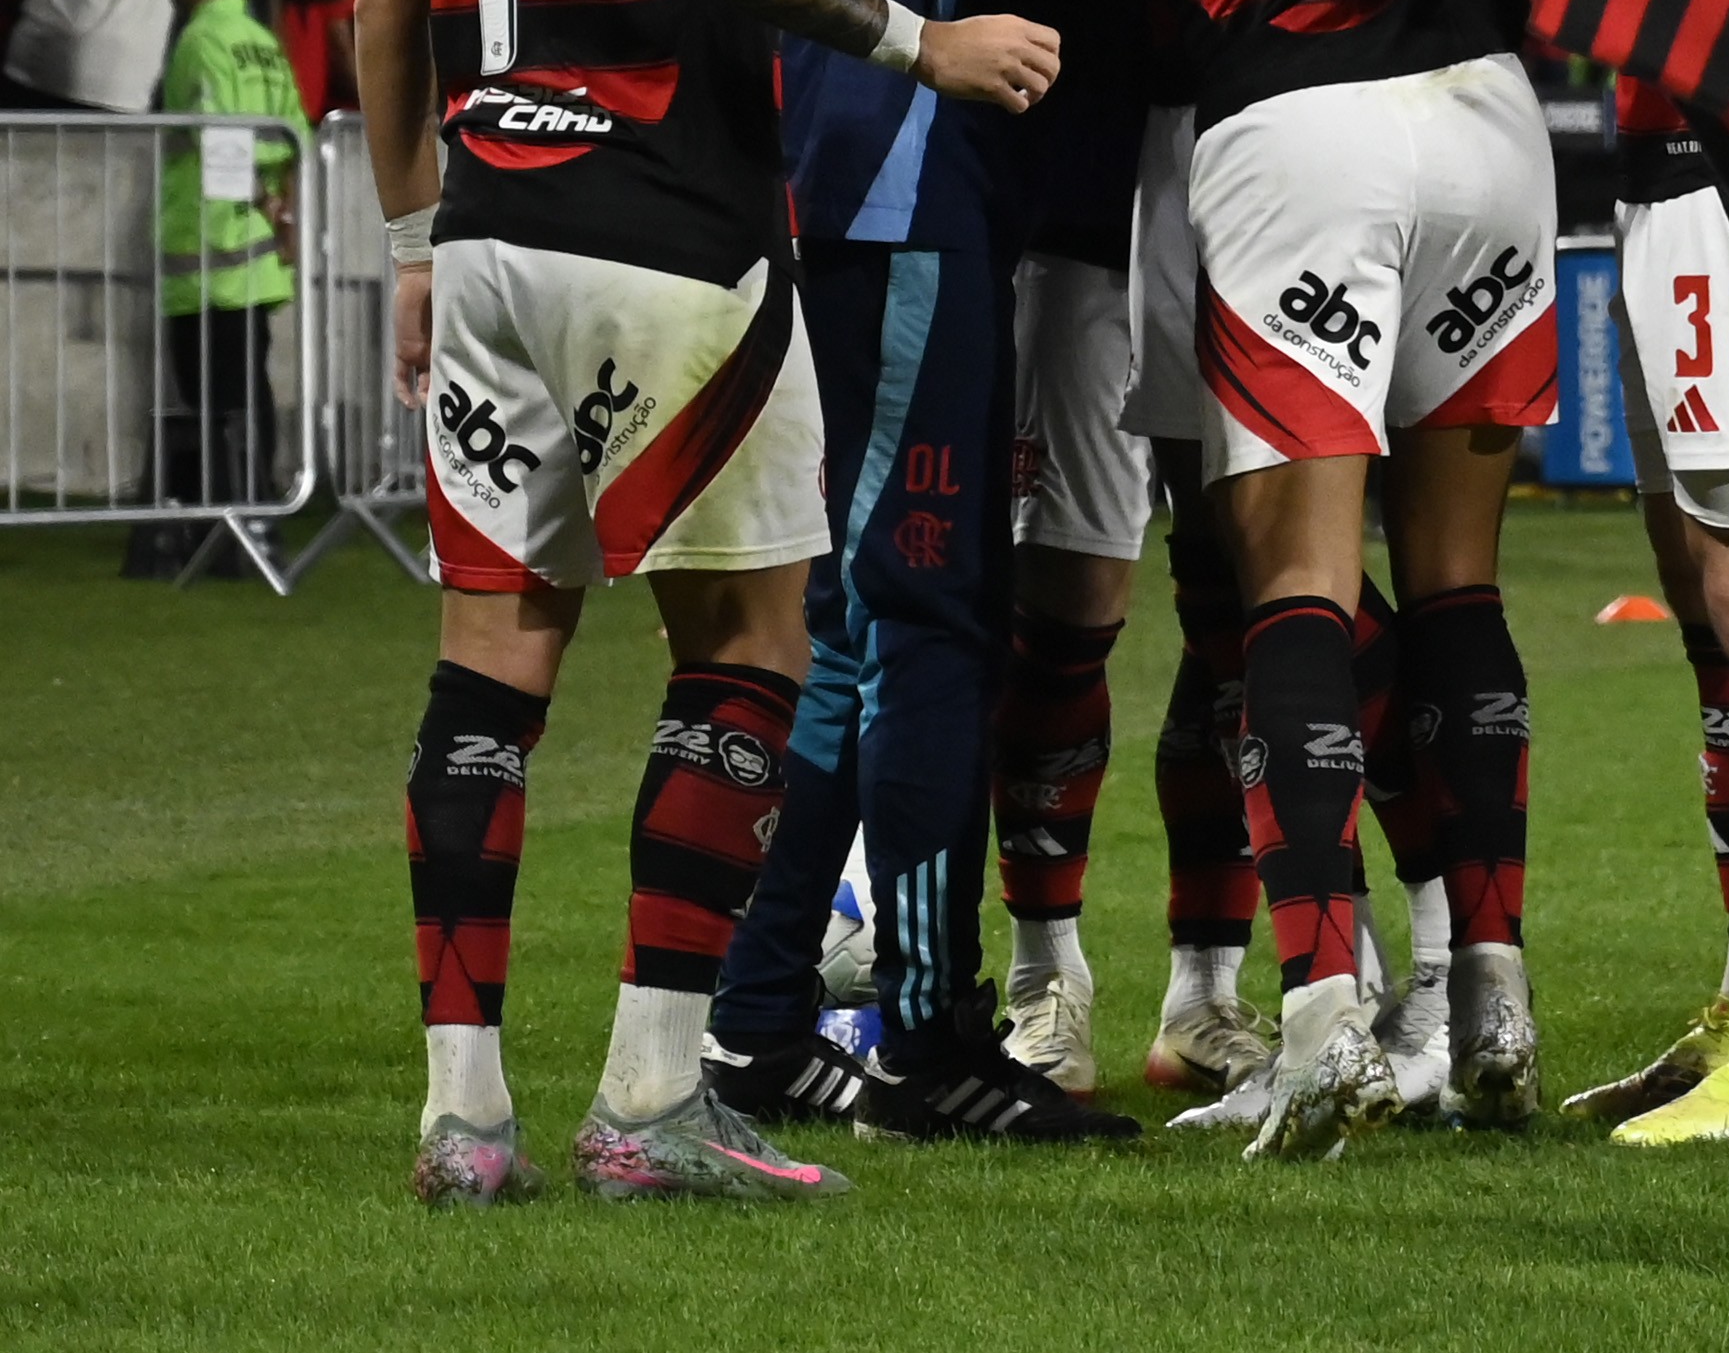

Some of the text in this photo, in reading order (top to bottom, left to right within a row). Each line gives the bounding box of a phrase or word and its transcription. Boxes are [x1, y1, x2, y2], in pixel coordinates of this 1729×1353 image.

[1263, 311, 1361, 388] da construção
[1279, 269, 1382, 371] abc
[1425, 245, 1534, 354] abc
[1458, 277, 1545, 369] da construção
[1673, 275, 1714, 378] 3
[438, 380, 541, 494] abc
[439, 433, 501, 509] construção
